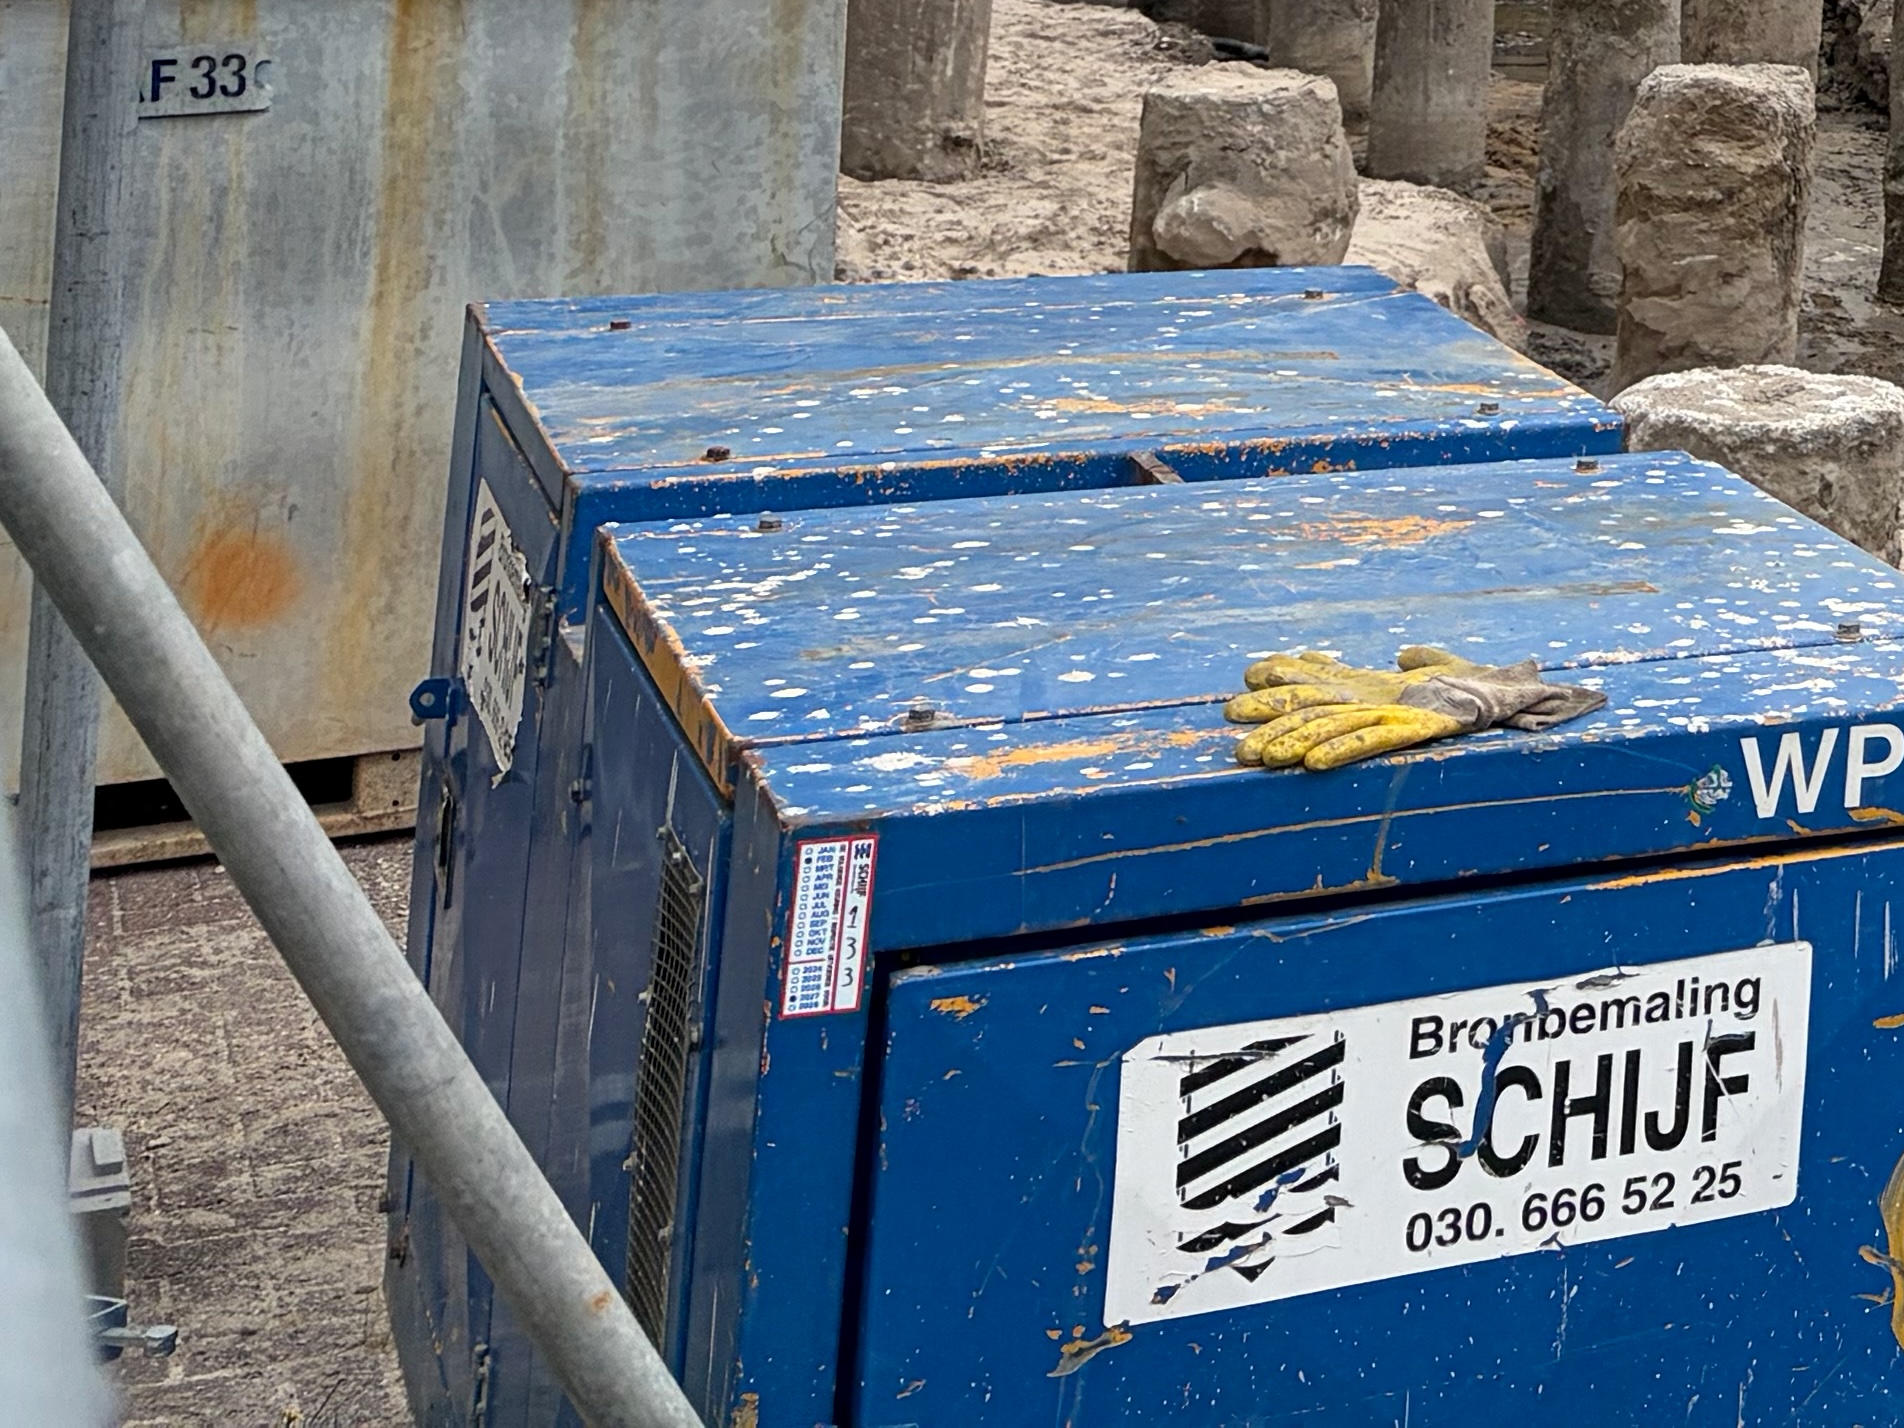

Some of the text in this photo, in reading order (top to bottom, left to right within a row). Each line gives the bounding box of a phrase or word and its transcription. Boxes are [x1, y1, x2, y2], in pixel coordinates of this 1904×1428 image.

[817, 846, 836, 854] JAN
[816, 855, 833, 863] FEB
[814, 873, 833, 881] APR
[812, 892, 830, 900] JUN
[811, 901, 826, 909] JUL
[811, 909, 829, 917] AUG
[809, 919, 827, 928] SEP
[808, 928, 827, 937] OKT
[807, 937, 826, 945] NOV
[806, 947, 824, 955] DEC
[1402, 1030, 1756, 1192] SCHIJF
[1406, 1160, 1743, 1252] 030. 666 52 25
